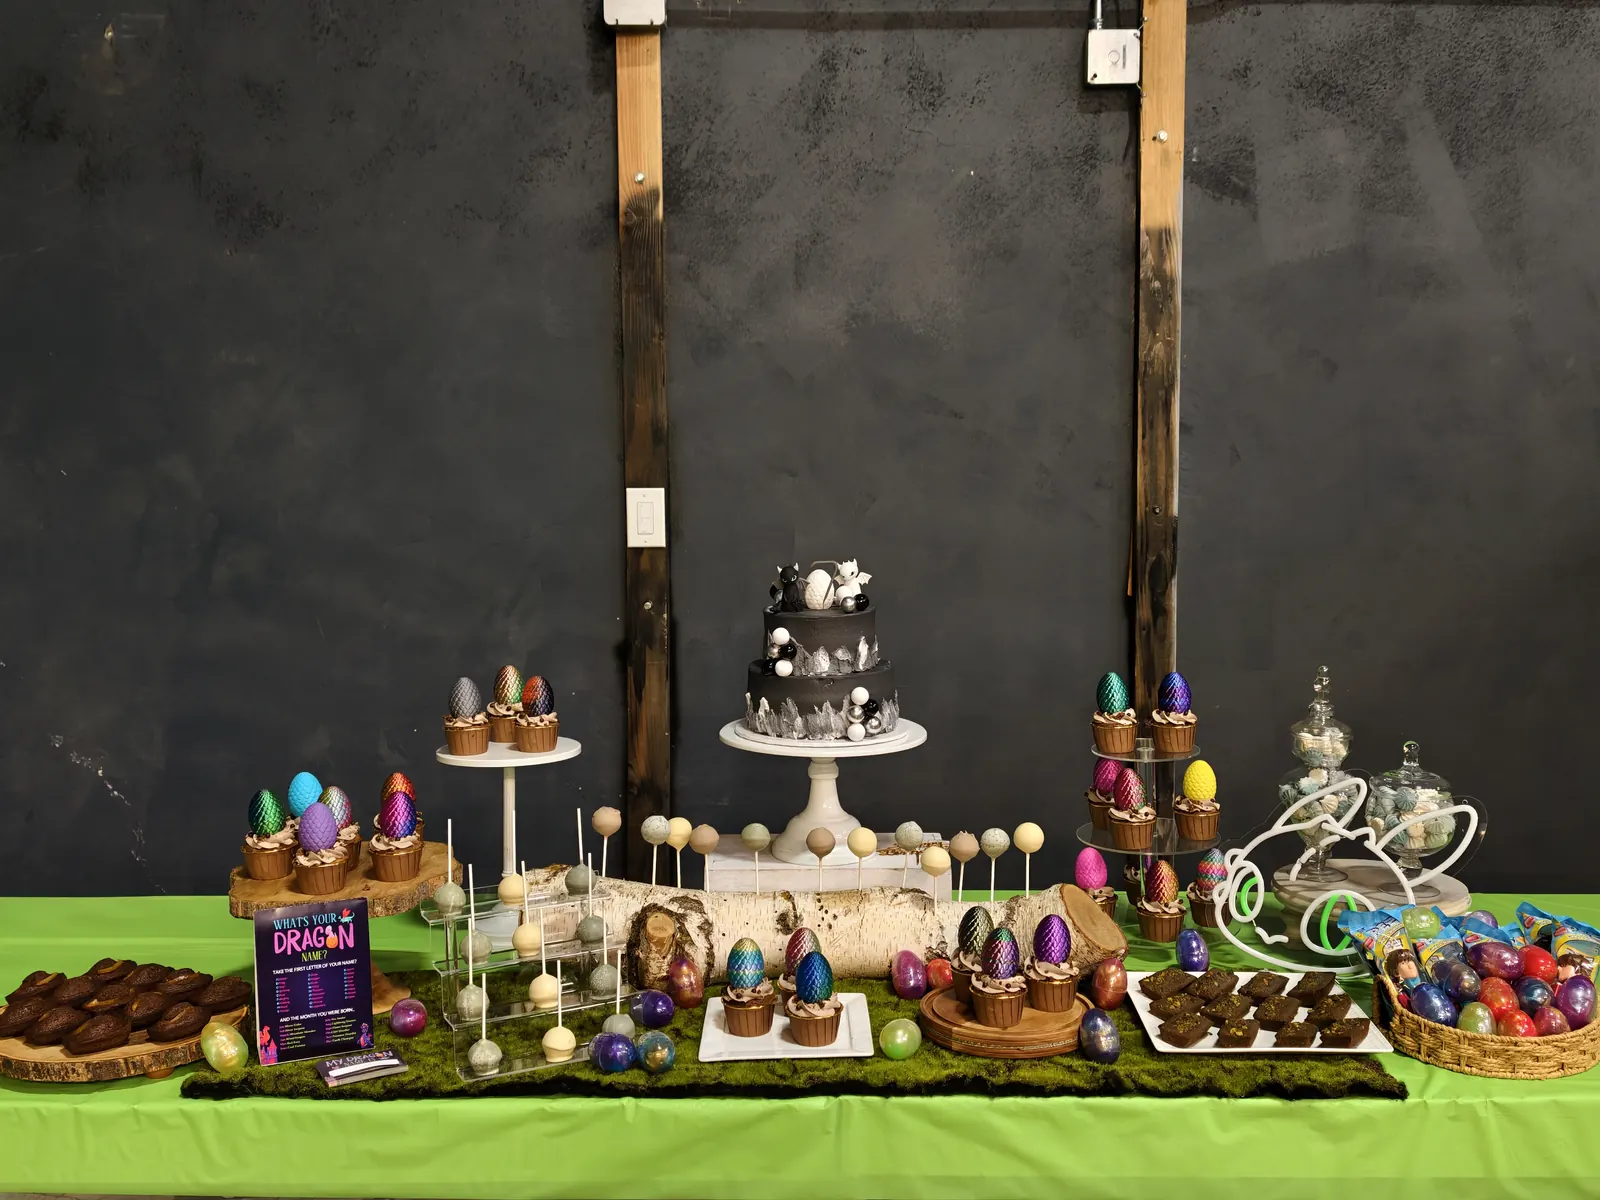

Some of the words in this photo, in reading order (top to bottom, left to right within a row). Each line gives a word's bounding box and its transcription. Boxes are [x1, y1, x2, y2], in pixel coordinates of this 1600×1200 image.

[312, 912, 337, 925] YOUR
[273, 922, 354, 955] DRAGON
[301, 949, 328, 962] NAME?
[306, 963, 322, 971] LETTER
[300, 1012, 317, 1020] MONTH
[325, 1058, 343, 1067] MY
